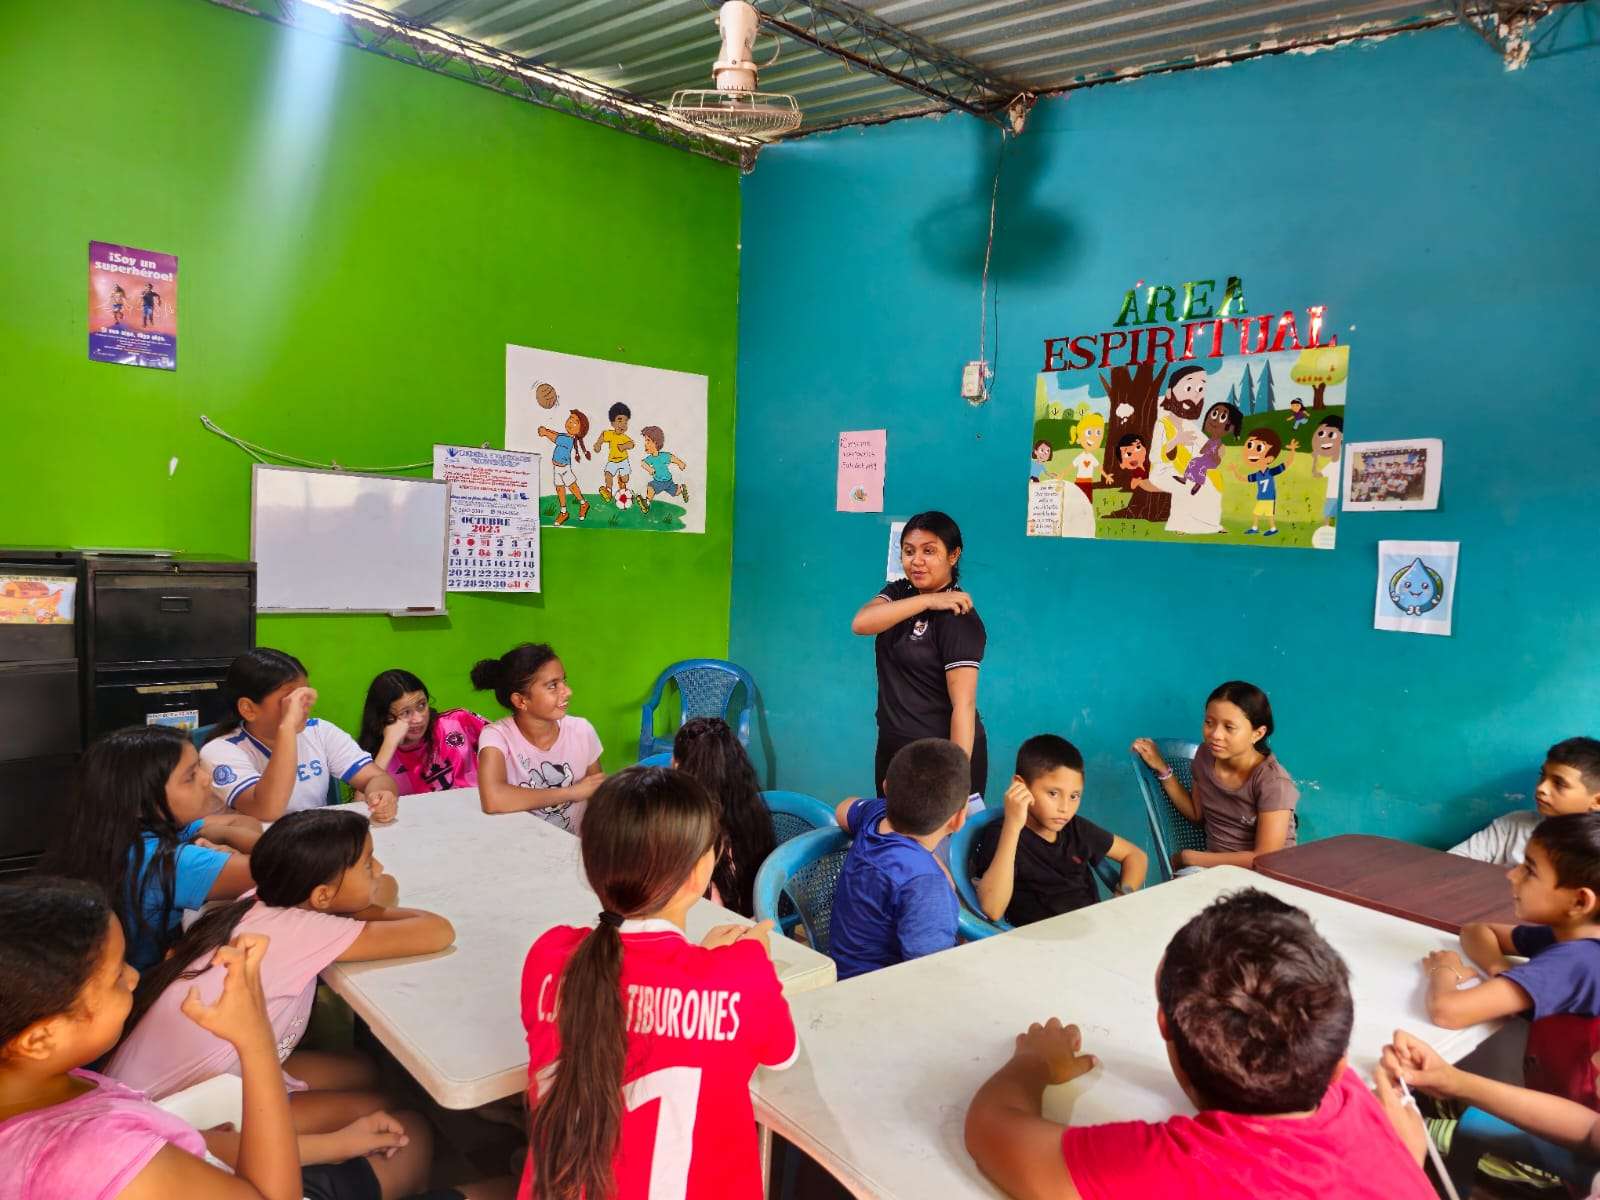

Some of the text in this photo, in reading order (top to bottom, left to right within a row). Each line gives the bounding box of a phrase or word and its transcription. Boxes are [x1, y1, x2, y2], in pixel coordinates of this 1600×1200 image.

[109, 252, 156, 269] ¡Soy un
[95, 261, 173, 282] superhéroe!
[1041, 304, 1337, 372] ESPIRITUAL
[461, 516, 510, 526] OCTUBRE
[472, 525, 500, 533] 2025
[448, 569, 462, 577] 20
[625, 983, 741, 1041] TIBURONES
